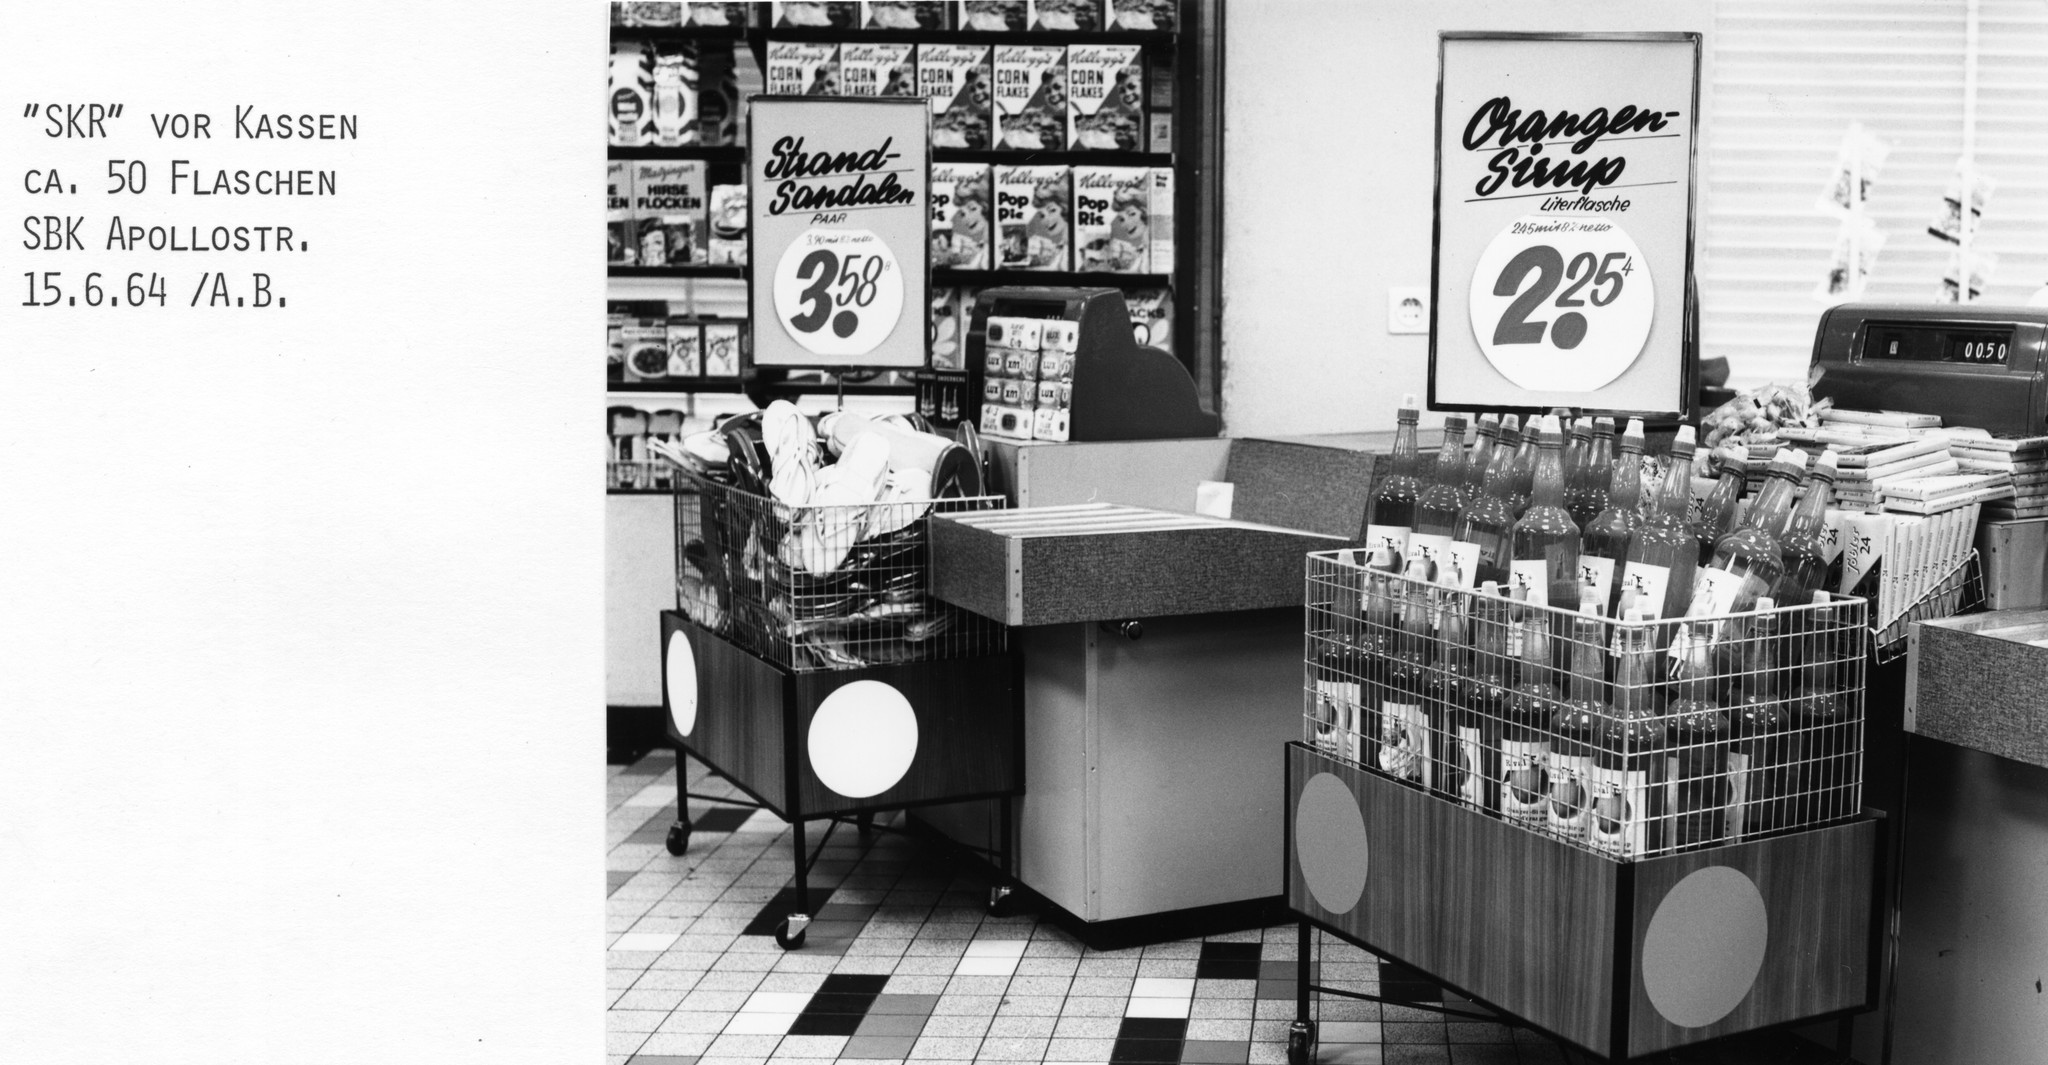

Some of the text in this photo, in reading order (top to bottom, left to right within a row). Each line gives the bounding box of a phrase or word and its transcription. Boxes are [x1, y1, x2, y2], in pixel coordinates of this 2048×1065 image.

[770, 66, 802, 81] CORN
[844, 67, 876, 82] CORN
[921, 68, 953, 83] CORN
[997, 69, 1029, 84] CORN
[1071, 70, 1103, 85] CORN
[997, 86, 1029, 98] FLAKES
[1071, 86, 1103, 99] FLAKES
[24, 103, 124, 138] "SKR"
[1462, 96, 1680, 154] Orangen-
[764, 135, 901, 179] Strand-
[107, 160, 147, 194] 50
[932, 167, 984, 187] ellogg's
[1475, 142, 1626, 196] Sirup
[648, 184, 689, 196] HIRSE
[769, 173, 915, 215] Sandalen
[637, 197, 701, 209] FLOCKEN
[932, 194, 949, 207] op
[998, 192, 1029, 209] Pop
[1078, 195, 1109, 213] Pop
[1540, 195, 1631, 212] Literflasche
[810, 213, 847, 225] PAAR
[932, 207, 945, 222] is
[1078, 211, 1104, 226] Ris
[23, 216, 85, 251] SBK
[22, 271, 286, 307] 15.6.64 /A.B.
[1130, 308, 1165, 319] ACKS
[986, 386, 998, 394] LUX
[1041, 390, 1054, 398] LUX
[1686, 488, 1695, 523] obler
[1694, 497, 1704, 513] 24
[1826, 528, 1839, 546] 24
[1846, 526, 1860, 575] Tobler
[1860, 537, 1871, 555] 24
